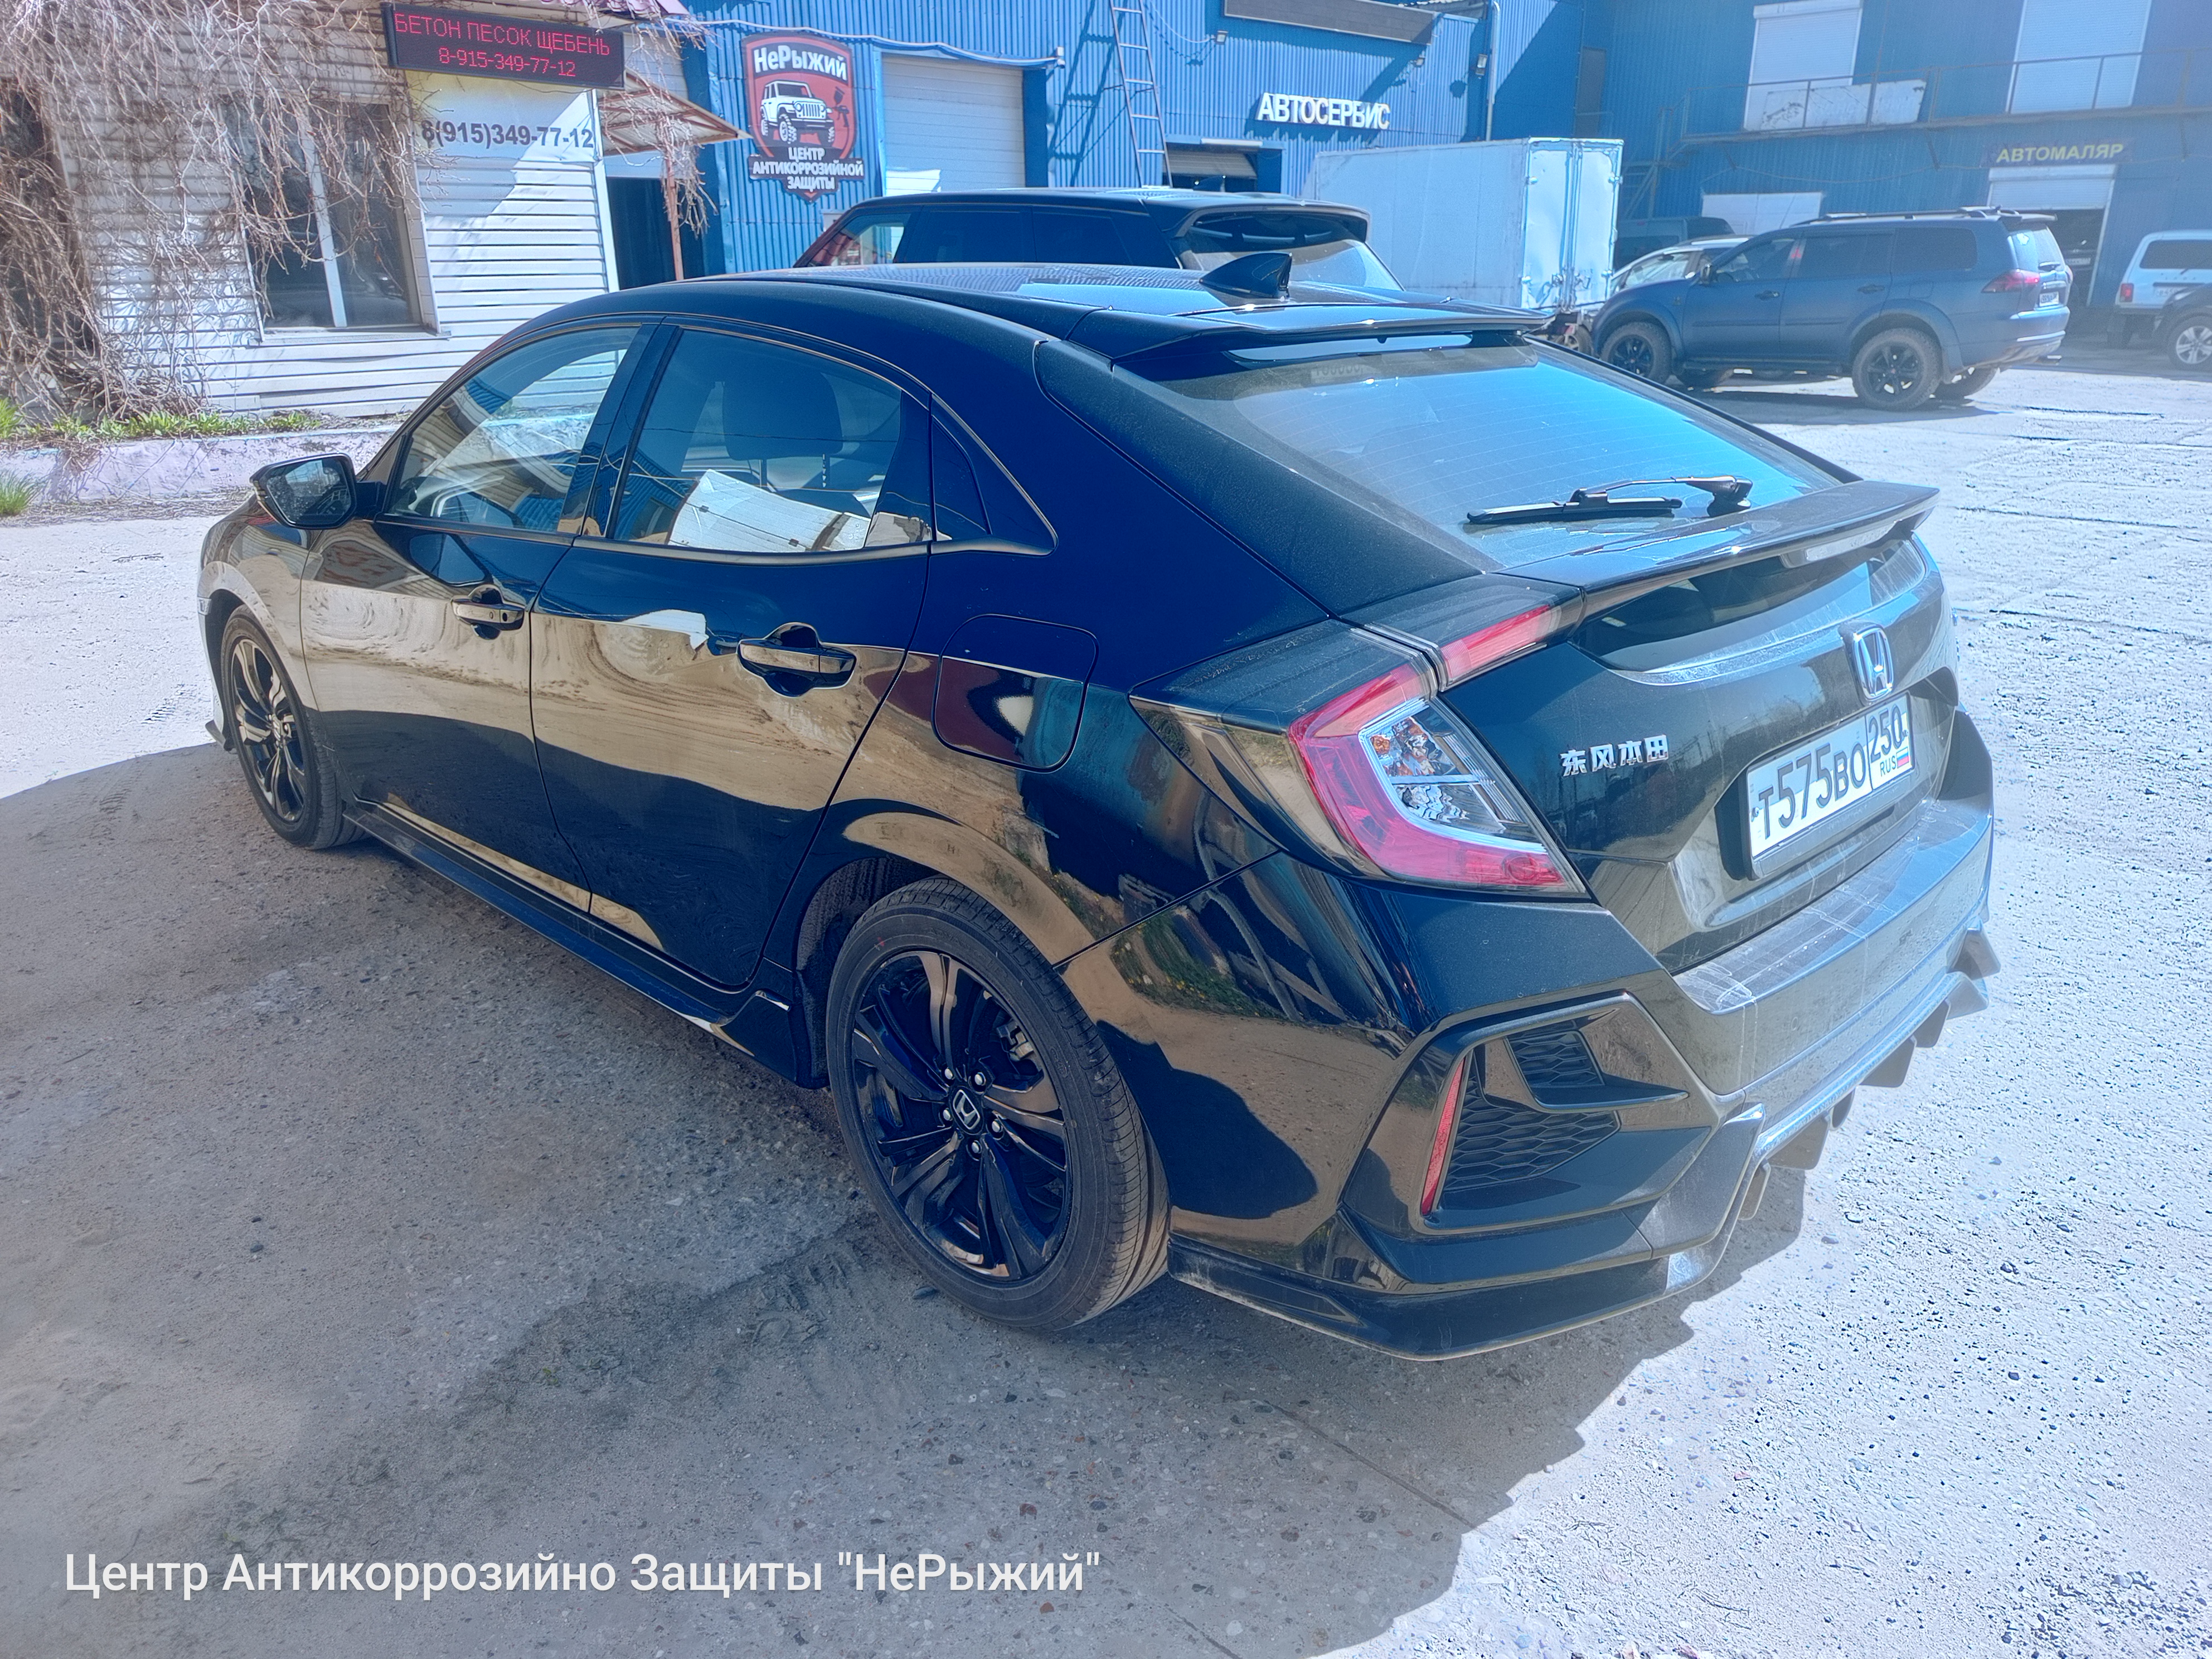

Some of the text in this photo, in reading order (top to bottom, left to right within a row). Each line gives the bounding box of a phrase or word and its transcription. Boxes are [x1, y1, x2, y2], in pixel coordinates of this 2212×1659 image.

[395, 13, 610, 55] БЕТОН ПЕСОК ЩЕБЕНЬ
[439, 47, 576, 76] 8-915-349-77-12
[1257, 92, 1391, 129] АВТОСЕРВИС
[421, 120, 594, 148] 8(915)349-77-12
[788, 147, 825, 162] ЦЕНТР
[1996, 143, 2123, 163] АВТОМАЛЯР
[753, 160, 864, 176] АНТИКОРРОЗИЙНОЙ
[787, 176, 835, 192] ЗАЩИТЫ
[1869, 705, 1903, 764] 250
[1560, 734, 1669, 778] 东风本田
[1880, 755, 1896, 777] RUS
